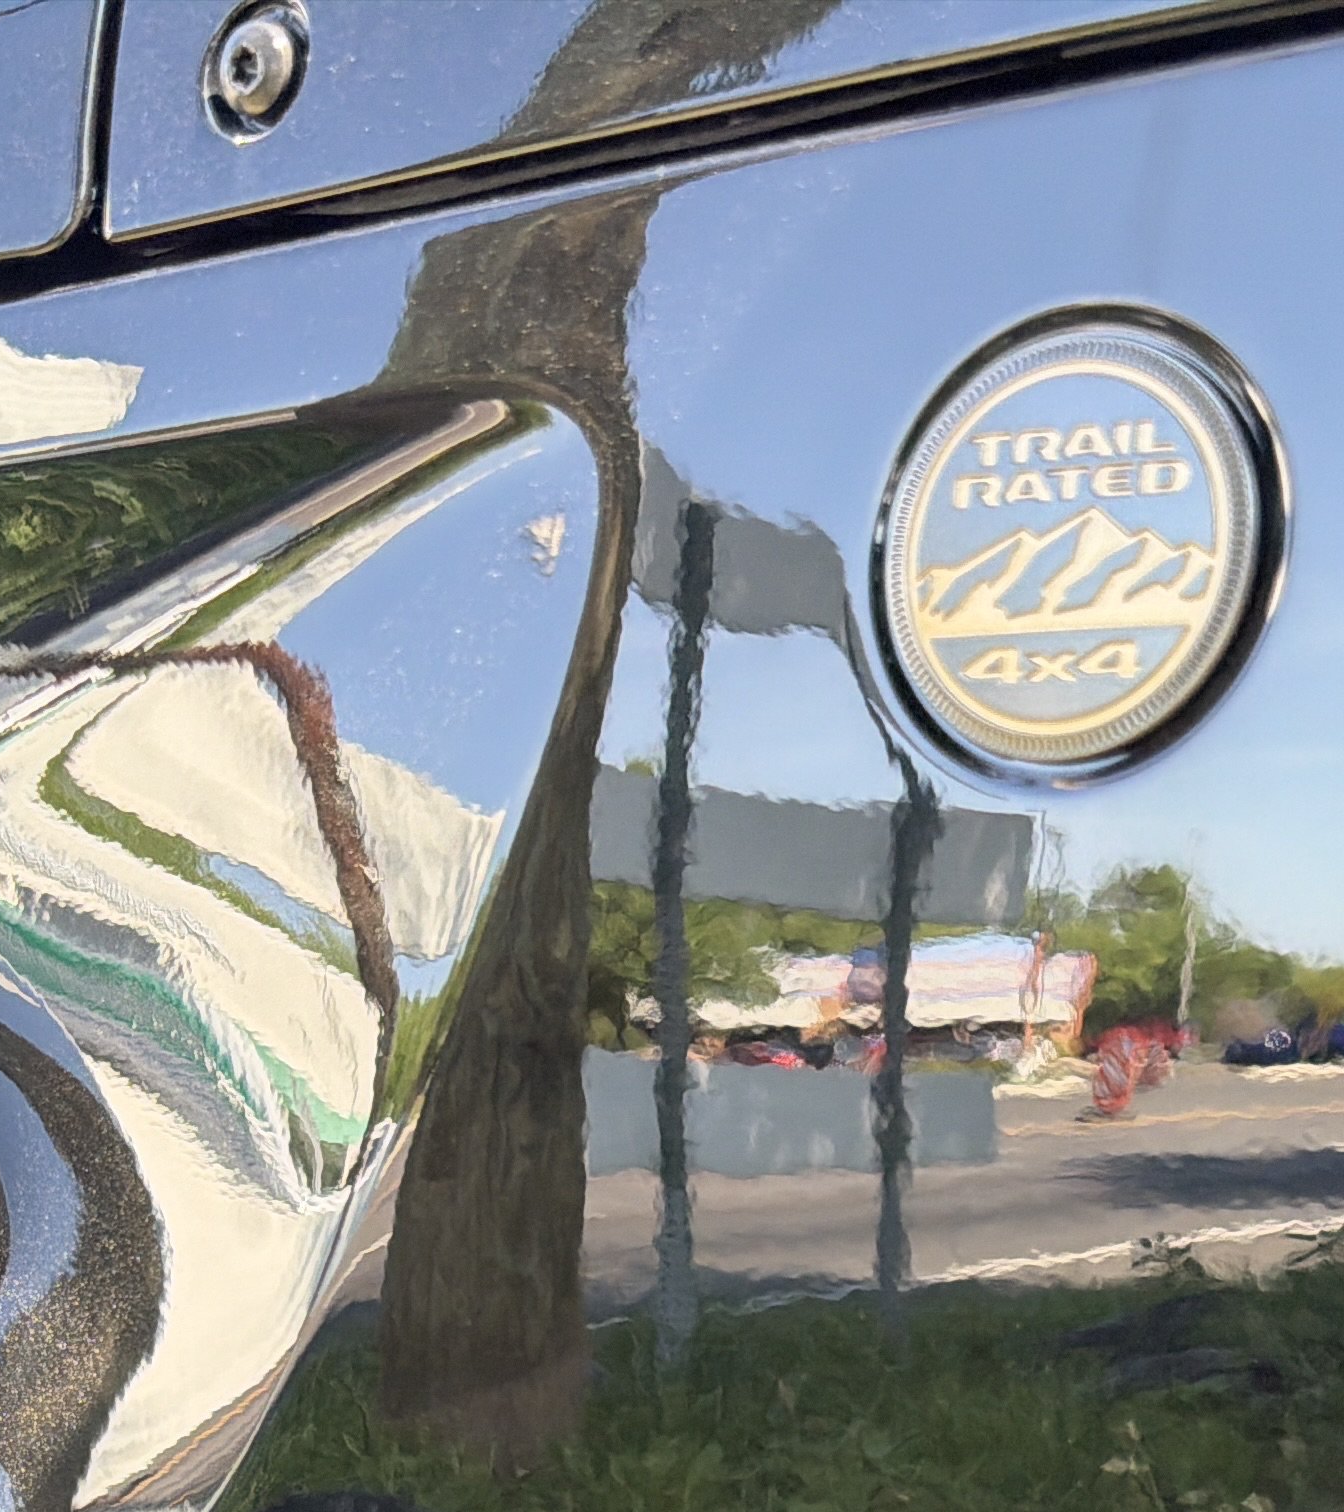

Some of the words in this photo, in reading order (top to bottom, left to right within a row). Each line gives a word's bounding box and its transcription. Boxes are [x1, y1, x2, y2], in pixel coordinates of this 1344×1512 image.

[973, 420, 1176, 467] TRAIL
[953, 459, 1191, 510] RATED
[962, 641, 1140, 684] 4x4
